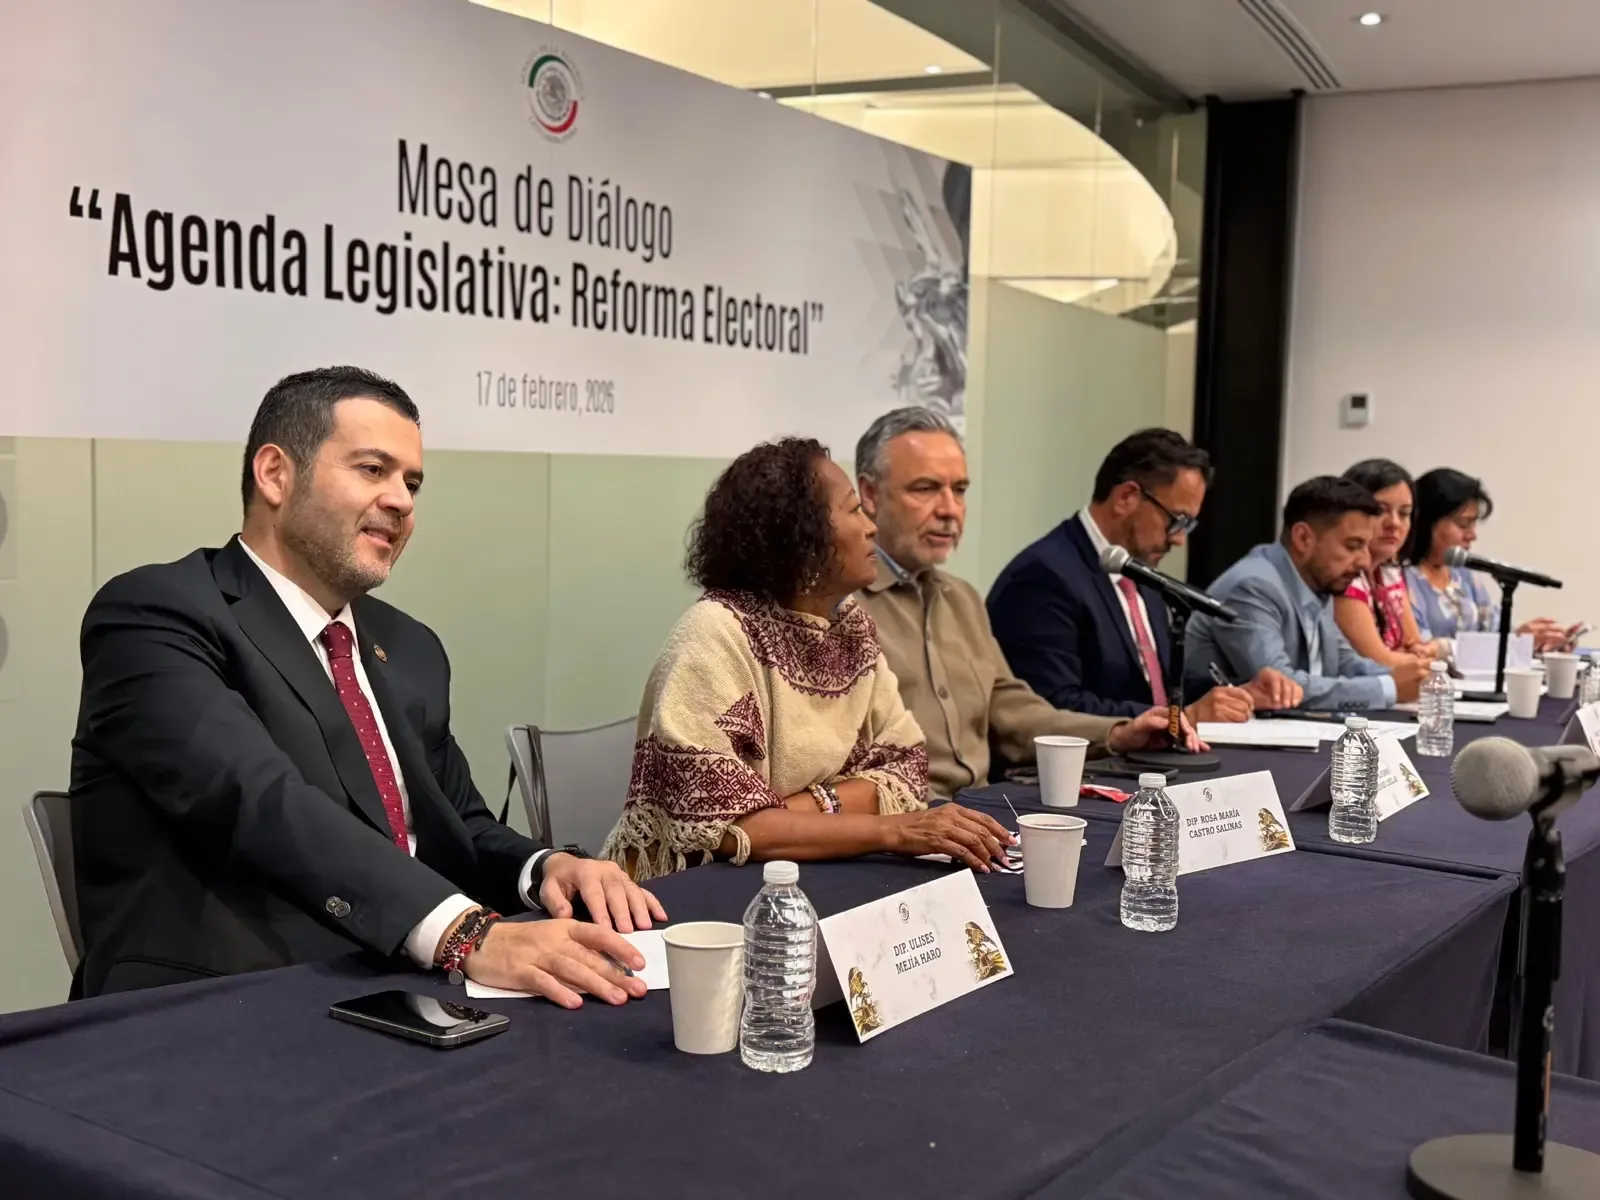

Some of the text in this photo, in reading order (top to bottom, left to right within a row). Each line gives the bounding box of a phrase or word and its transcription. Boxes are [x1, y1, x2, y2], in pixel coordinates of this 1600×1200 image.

[397, 138, 674, 264] Mesa de Diálogo
[68, 185, 824, 356] “Agenda Legislativa: Reforma Electoral”
[476, 370, 615, 418] 17 de febrero, 2026
[1186, 808, 1240, 827] DIP. ROSA MARÍA
[1189, 820, 1242, 838] CASTRO SALINAS
[893, 931, 935, 957] DIP. ULISES
[895, 947, 941, 974] MEJÍA HARO
